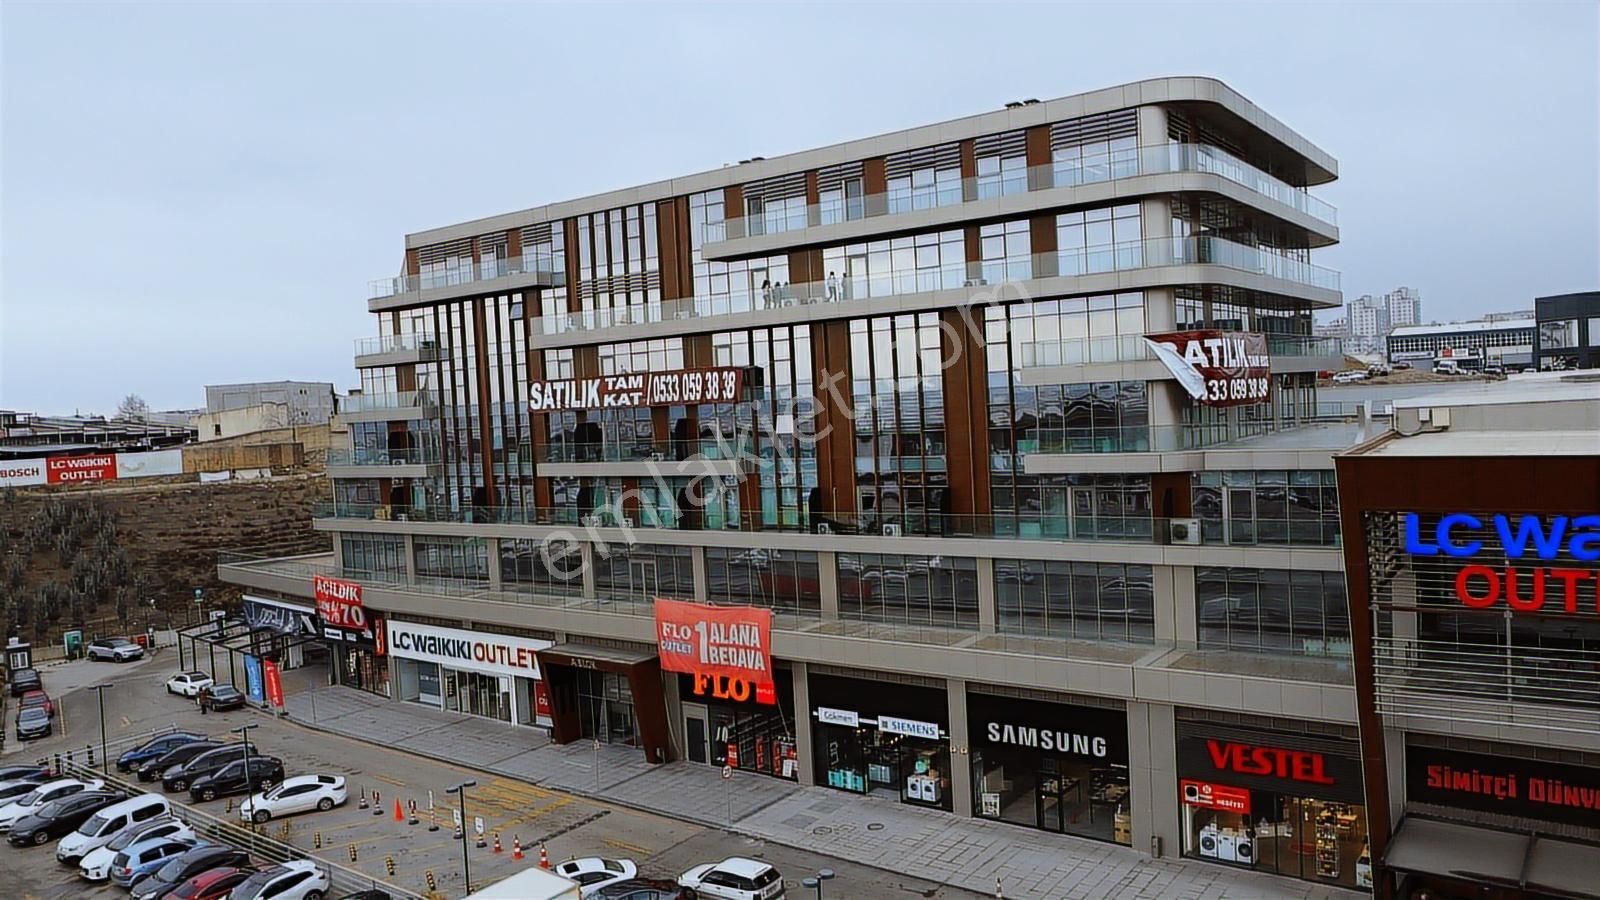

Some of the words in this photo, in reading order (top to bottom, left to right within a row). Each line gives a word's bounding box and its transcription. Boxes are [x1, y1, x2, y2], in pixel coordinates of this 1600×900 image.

[1184, 338, 1249, 368] ATILIK
[530, 378, 600, 410] SATILIK
[605, 375, 643, 391] TAM
[603, 392, 644, 407] KAT
[682, 373, 702, 400] 059
[705, 371, 719, 399] 38
[722, 370, 736, 400] 38
[0, 467, 39, 478] BOSCH
[50, 460, 65, 469] LC
[60, 469, 104, 480] OUTLET
[1405, 512, 1482, 557] LC
[1455, 564, 1600, 614] OUT
[662, 621, 692, 639] FLO
[695, 620, 709, 664] 1
[709, 622, 761, 649] ALANA
[392, 630, 411, 650] LC
[473, 642, 537, 669] OUTLET
[661, 642, 693, 655] OUTLET
[709, 646, 766, 671] BEDAVA
[693, 672, 750, 702] FLO
[891, 720, 936, 736] SIEMENS
[987, 722, 1107, 757] SAMSUNG
[1206, 738, 1335, 785] VESTEL
